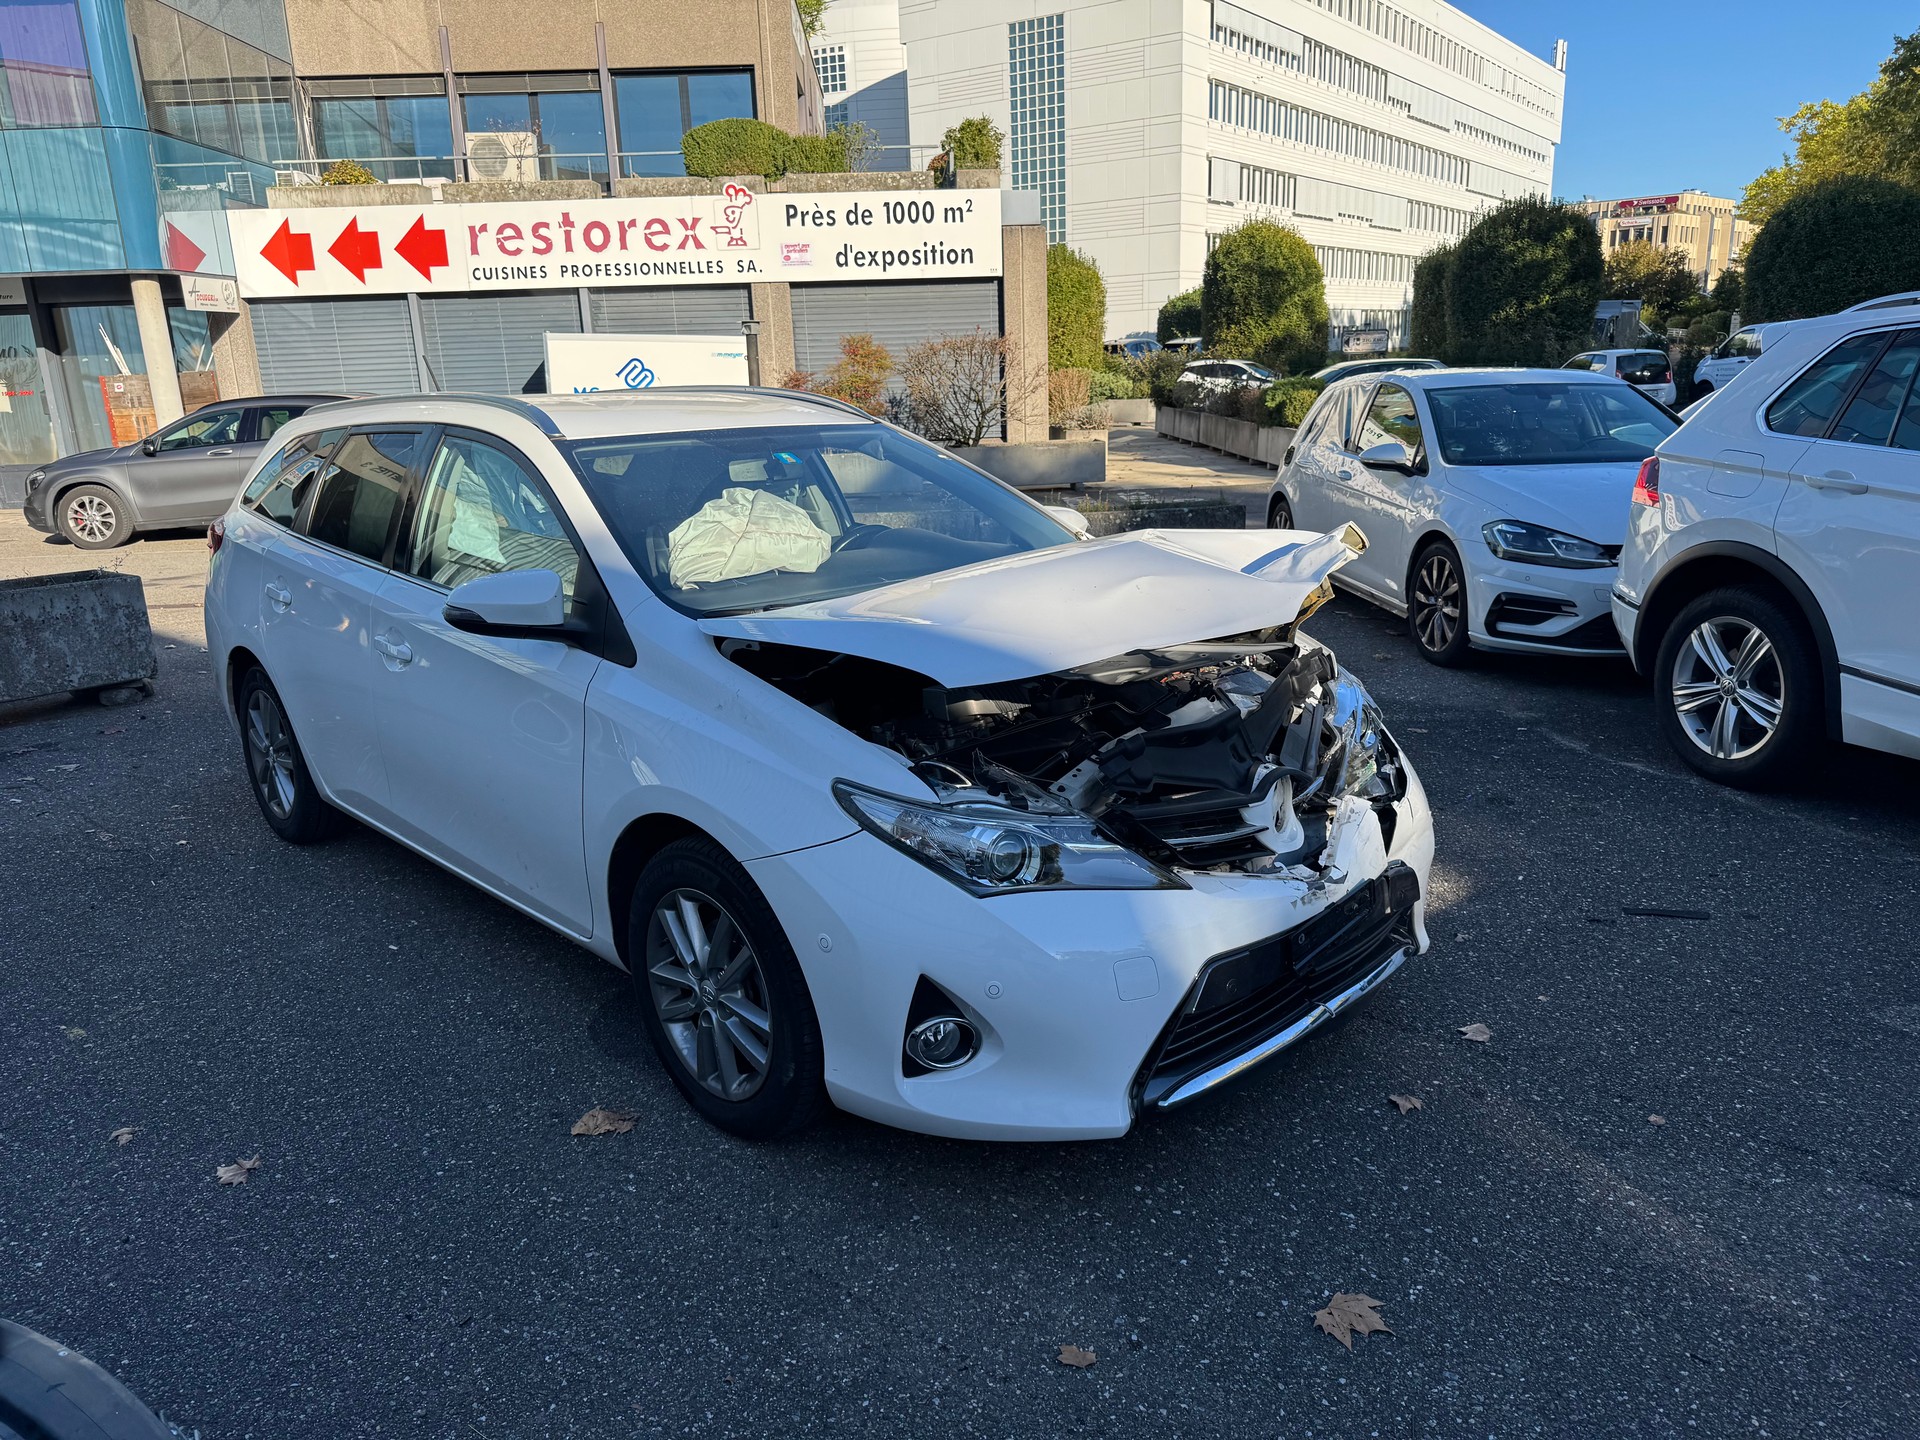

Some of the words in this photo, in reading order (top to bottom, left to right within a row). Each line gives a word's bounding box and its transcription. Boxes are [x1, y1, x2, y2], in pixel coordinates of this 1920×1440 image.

[785, 203, 837, 227] Près
[845, 202, 874, 226] de
[882, 200, 935, 225] 1000
[467, 211, 708, 257] restorex
[472, 265, 548, 281] CUISINES
[560, 259, 724, 278] PROFESSIONNELLES
[737, 259, 763, 273] SA.
[835, 241, 975, 273] d'exposition
